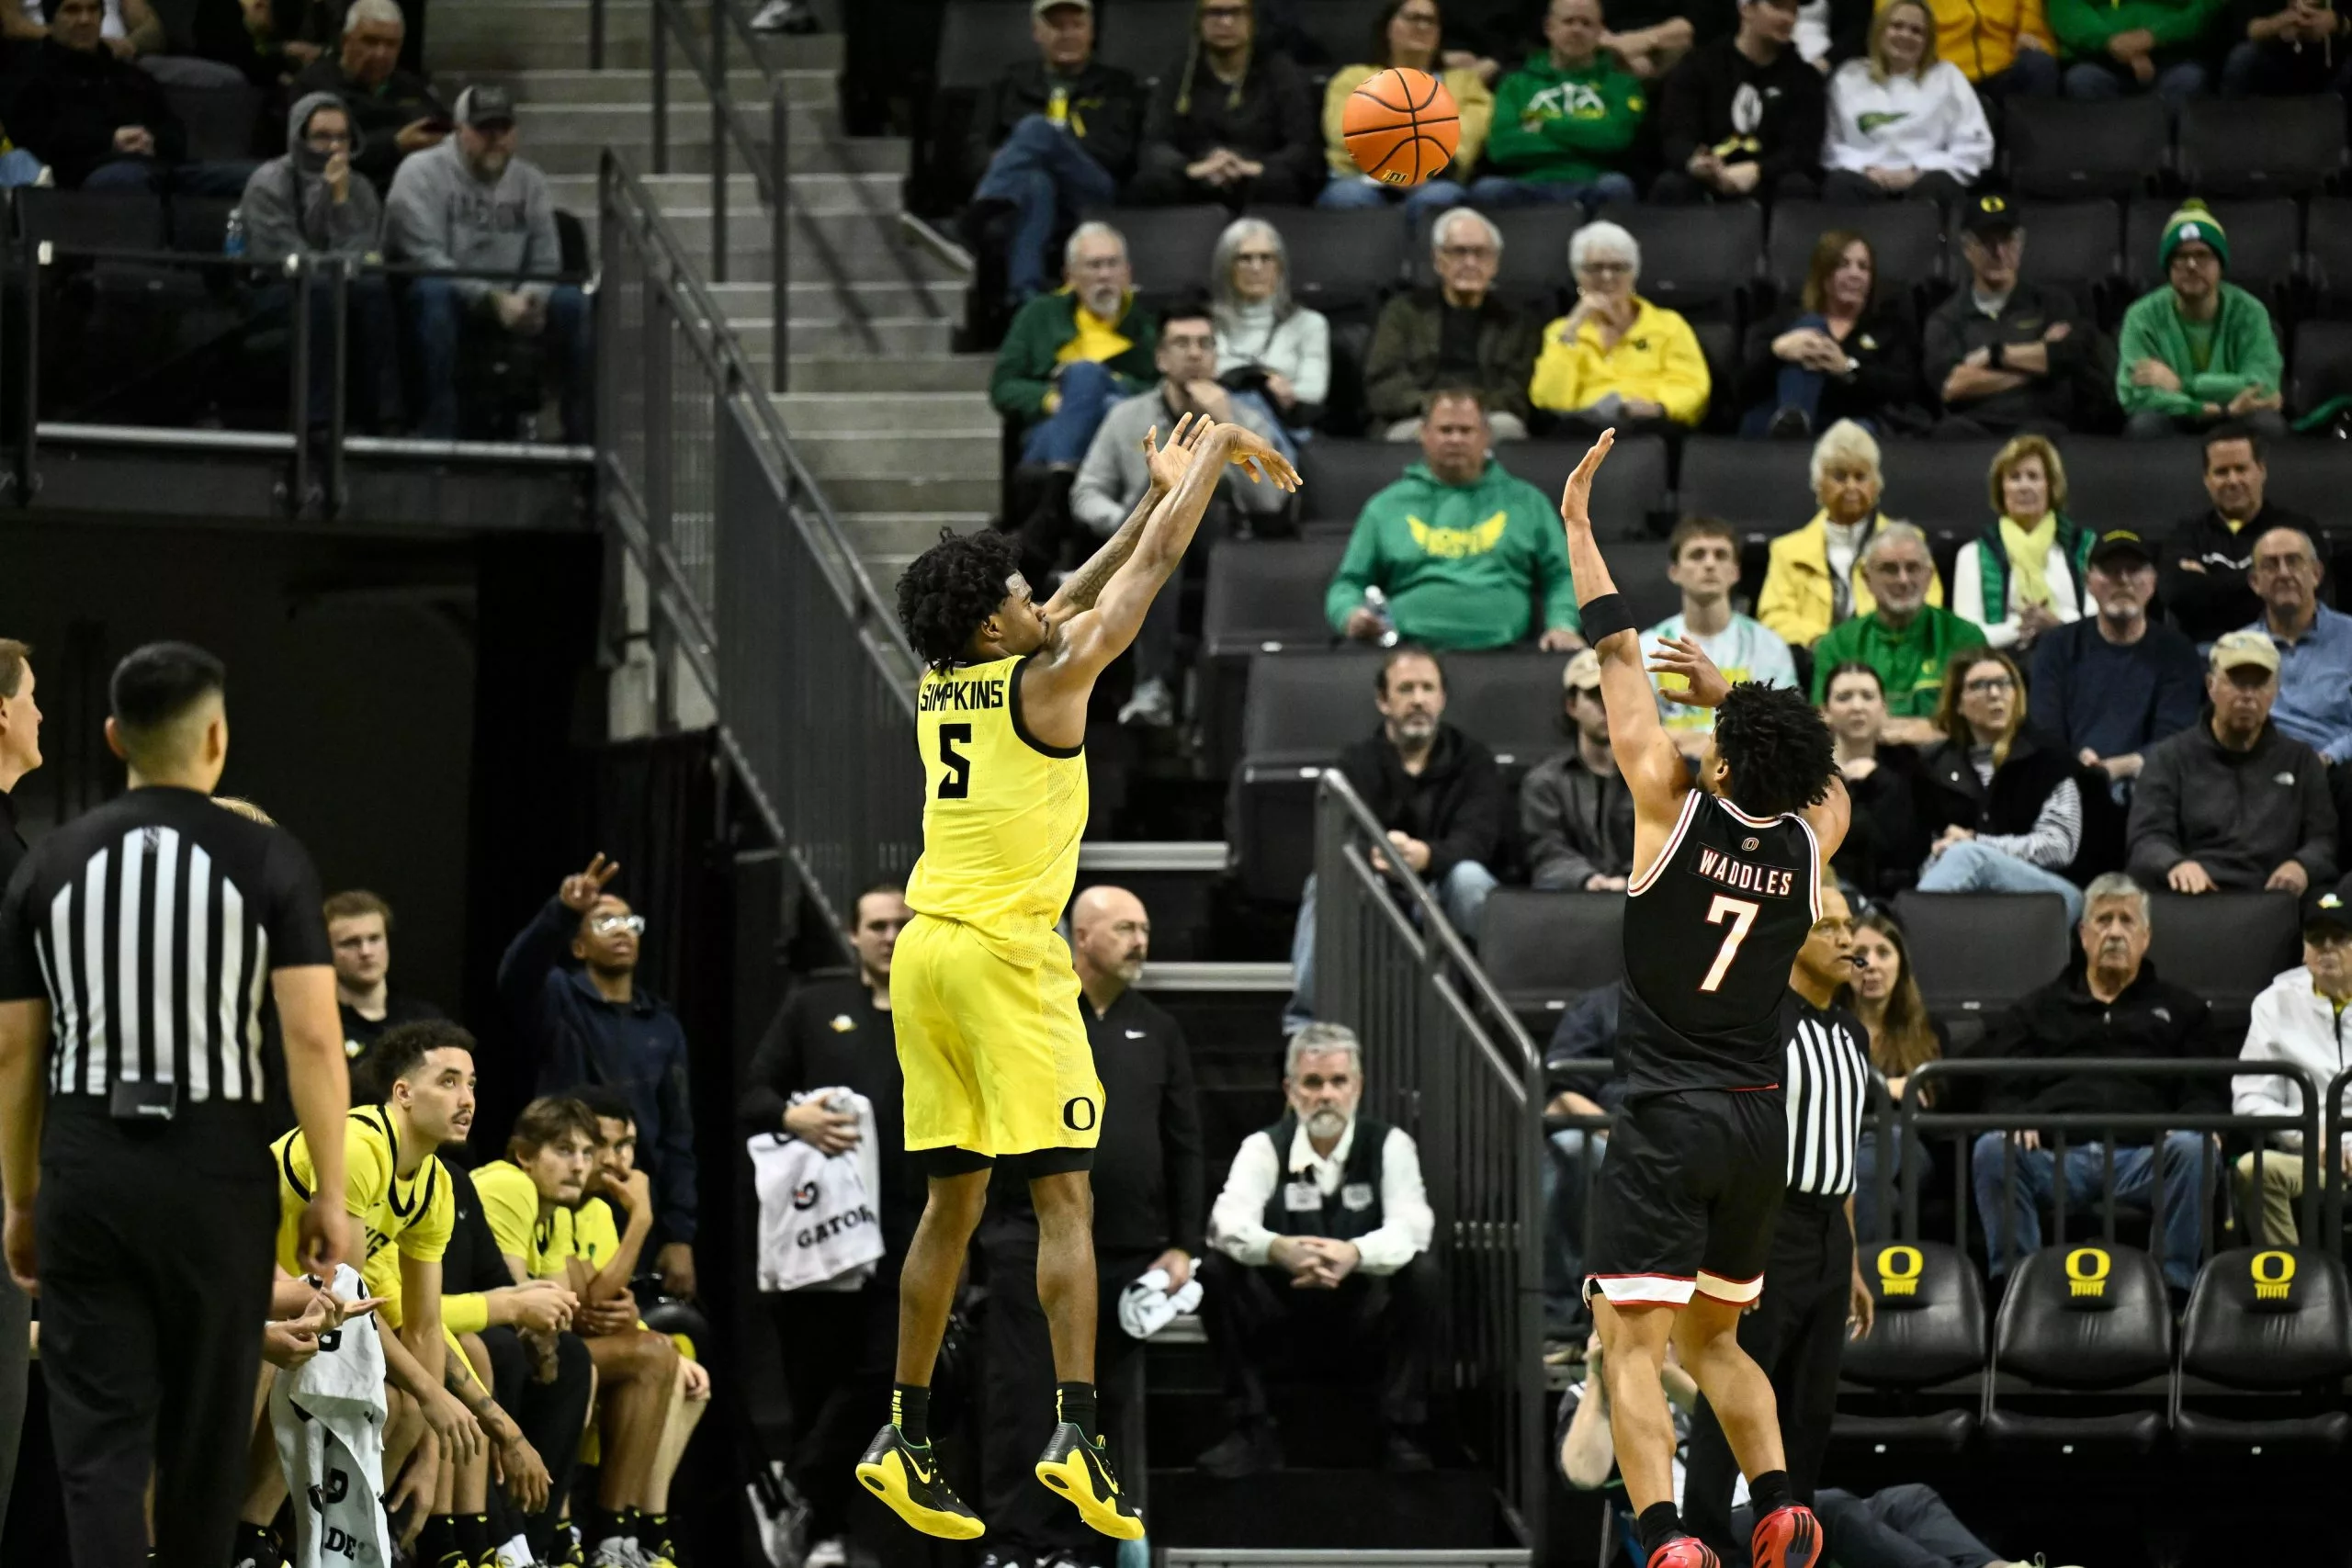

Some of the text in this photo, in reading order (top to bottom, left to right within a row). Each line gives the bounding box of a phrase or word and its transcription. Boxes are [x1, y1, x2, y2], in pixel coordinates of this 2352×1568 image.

[920, 680, 1004, 712] SIMPKINS
[938, 723, 972, 798] 5
[1741, 837, 1759, 851] O
[1699, 848, 1792, 897] WADDLES
[1697, 892, 1762, 993] 7
[1063, 1097, 1095, 1131] O
[1877, 1246, 1924, 1280] O
[2065, 1247, 2110, 1280] O
[2251, 1250, 2296, 1283] O
